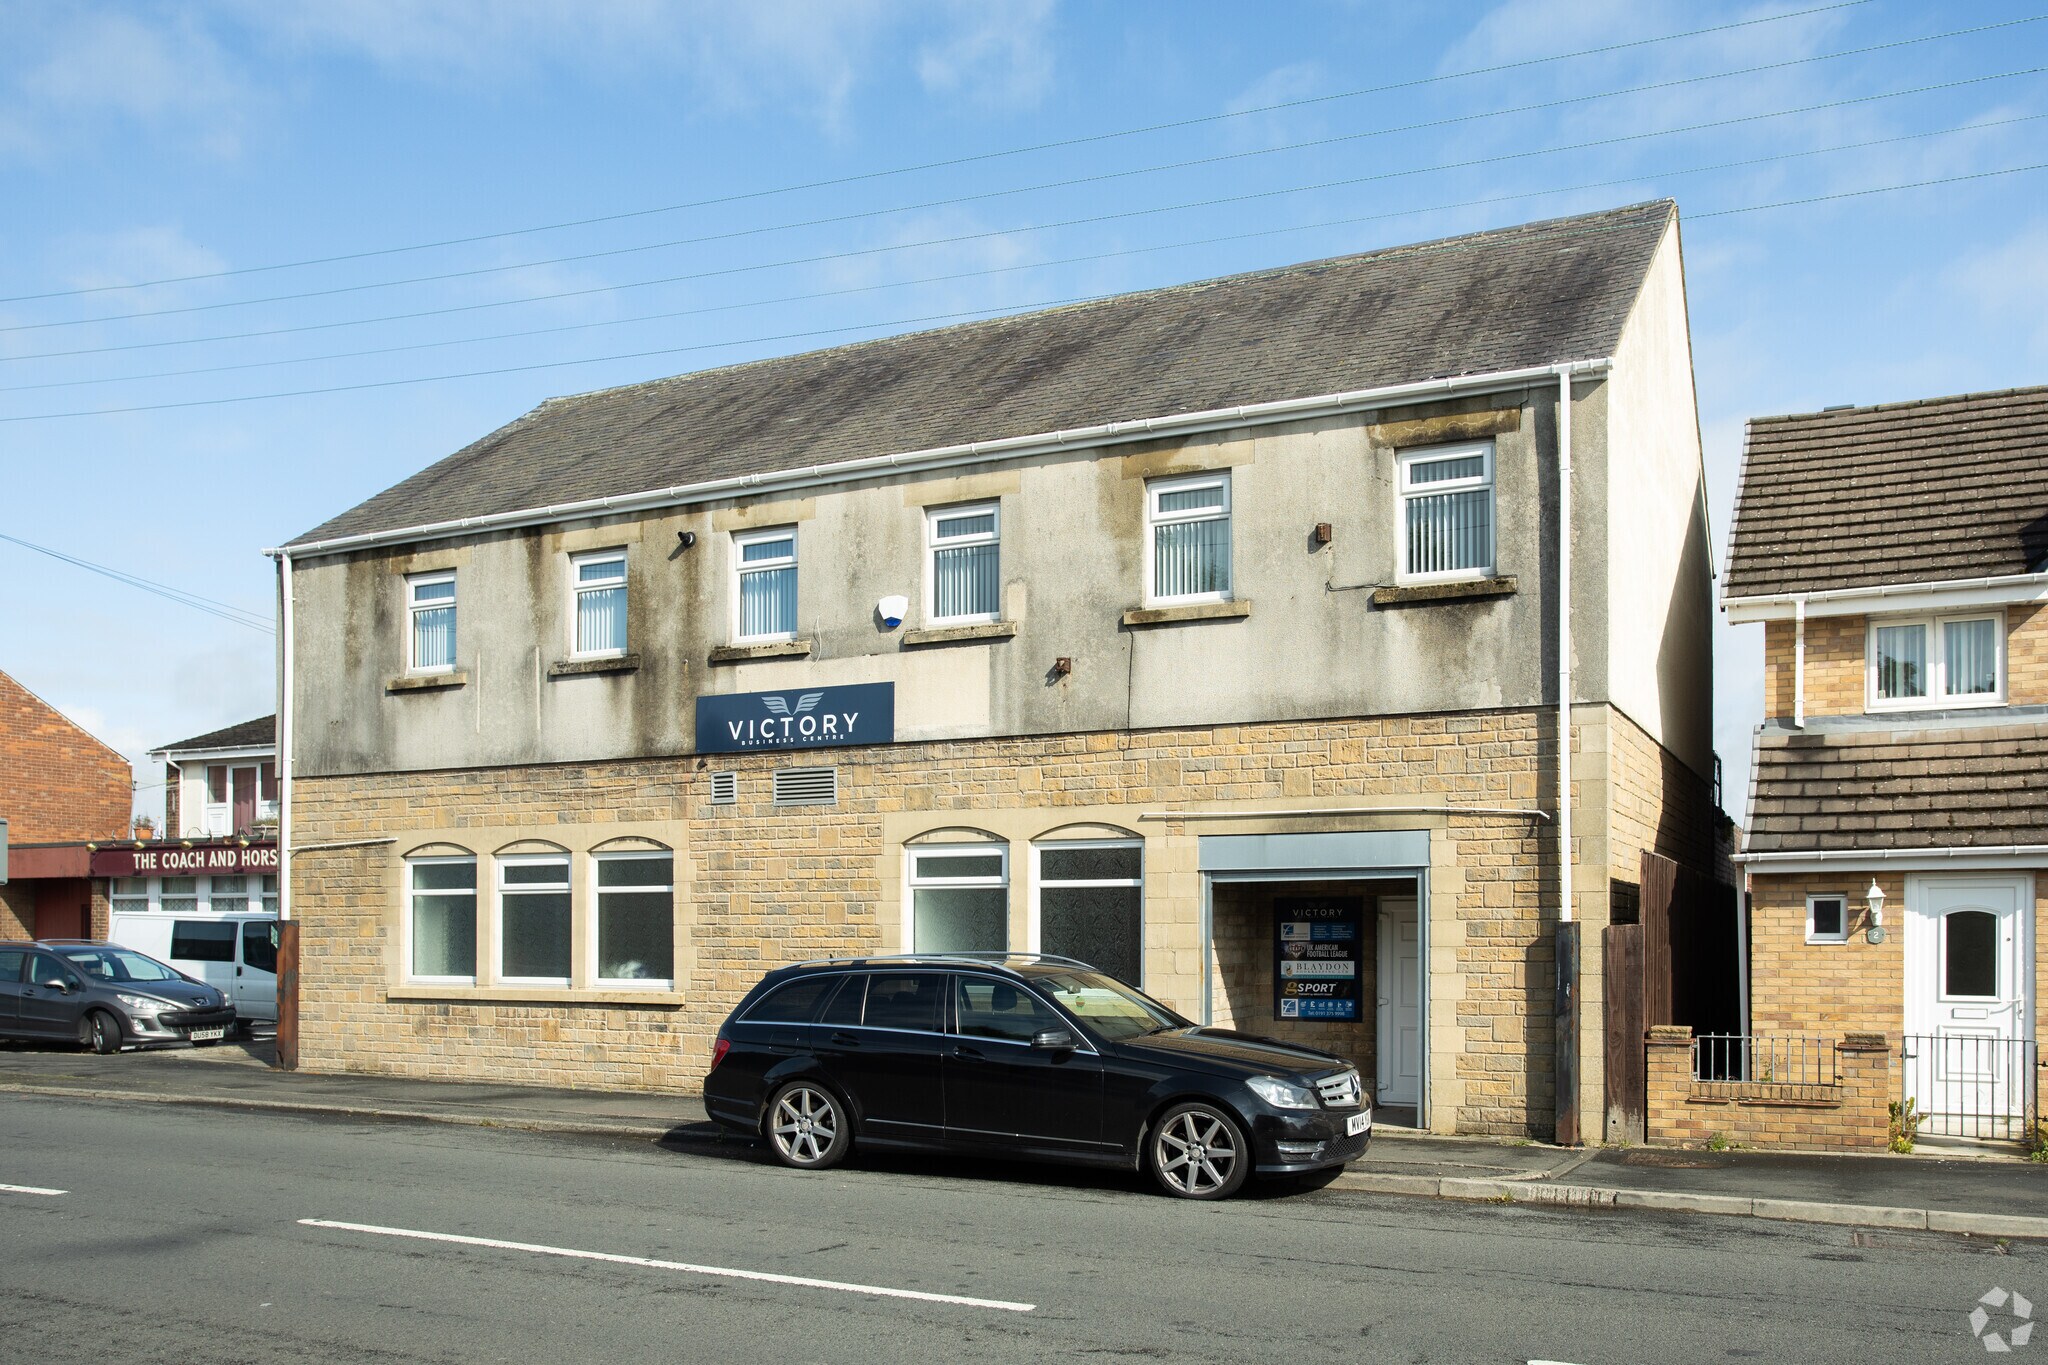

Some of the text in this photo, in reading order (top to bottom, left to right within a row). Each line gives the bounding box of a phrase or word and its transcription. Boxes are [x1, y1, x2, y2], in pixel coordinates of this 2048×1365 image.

[728, 712, 859, 741] VICTORY
[741, 734, 845, 746] BUSINESS CENTRE
[133, 849, 278, 869] THE COACH AND HORS
[1292, 908, 1343, 916] VICTORY
[1315, 943, 1339, 951] AMERICAN
[1306, 950, 1348, 958] FOOTBALL LEAGUE
